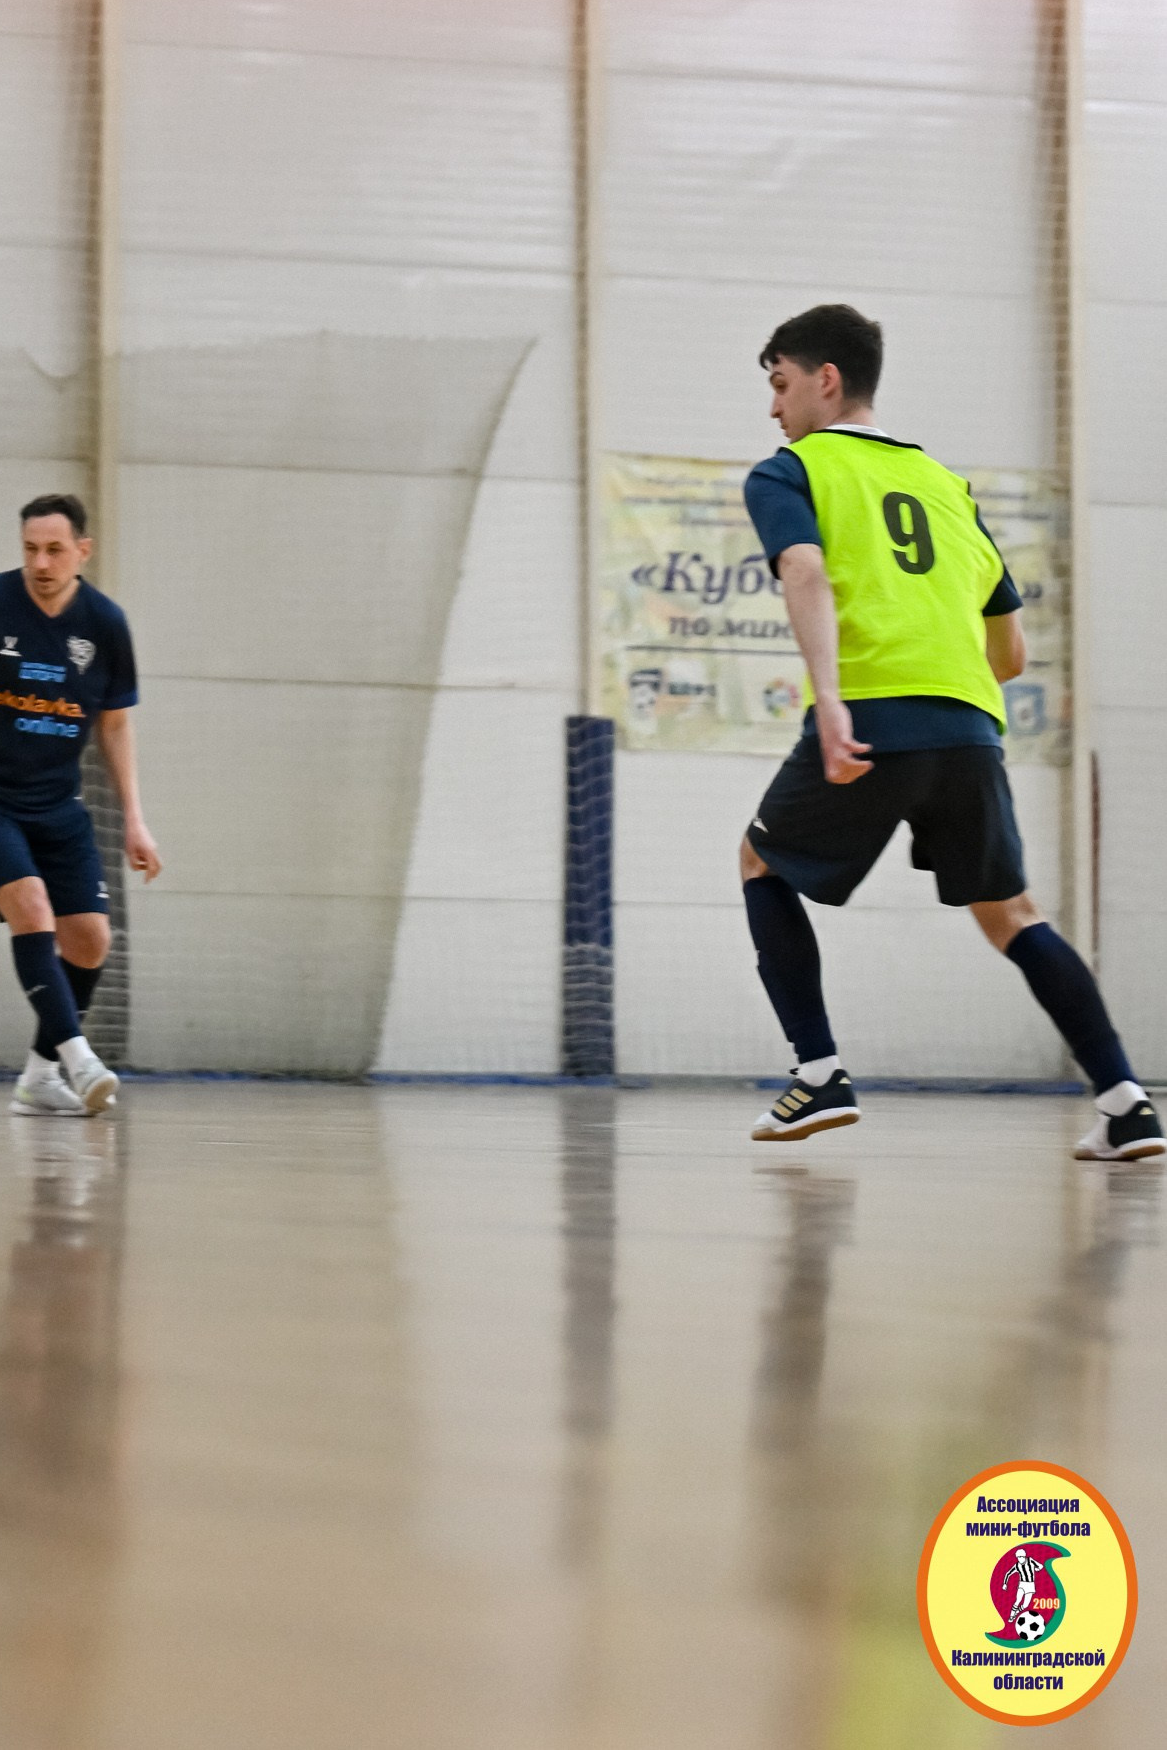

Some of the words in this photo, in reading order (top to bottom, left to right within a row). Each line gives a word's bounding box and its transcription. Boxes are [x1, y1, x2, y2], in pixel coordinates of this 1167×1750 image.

[881, 491, 936, 575] 9
[718, 617, 793, 639] мин
[14, 716, 80, 738] online
